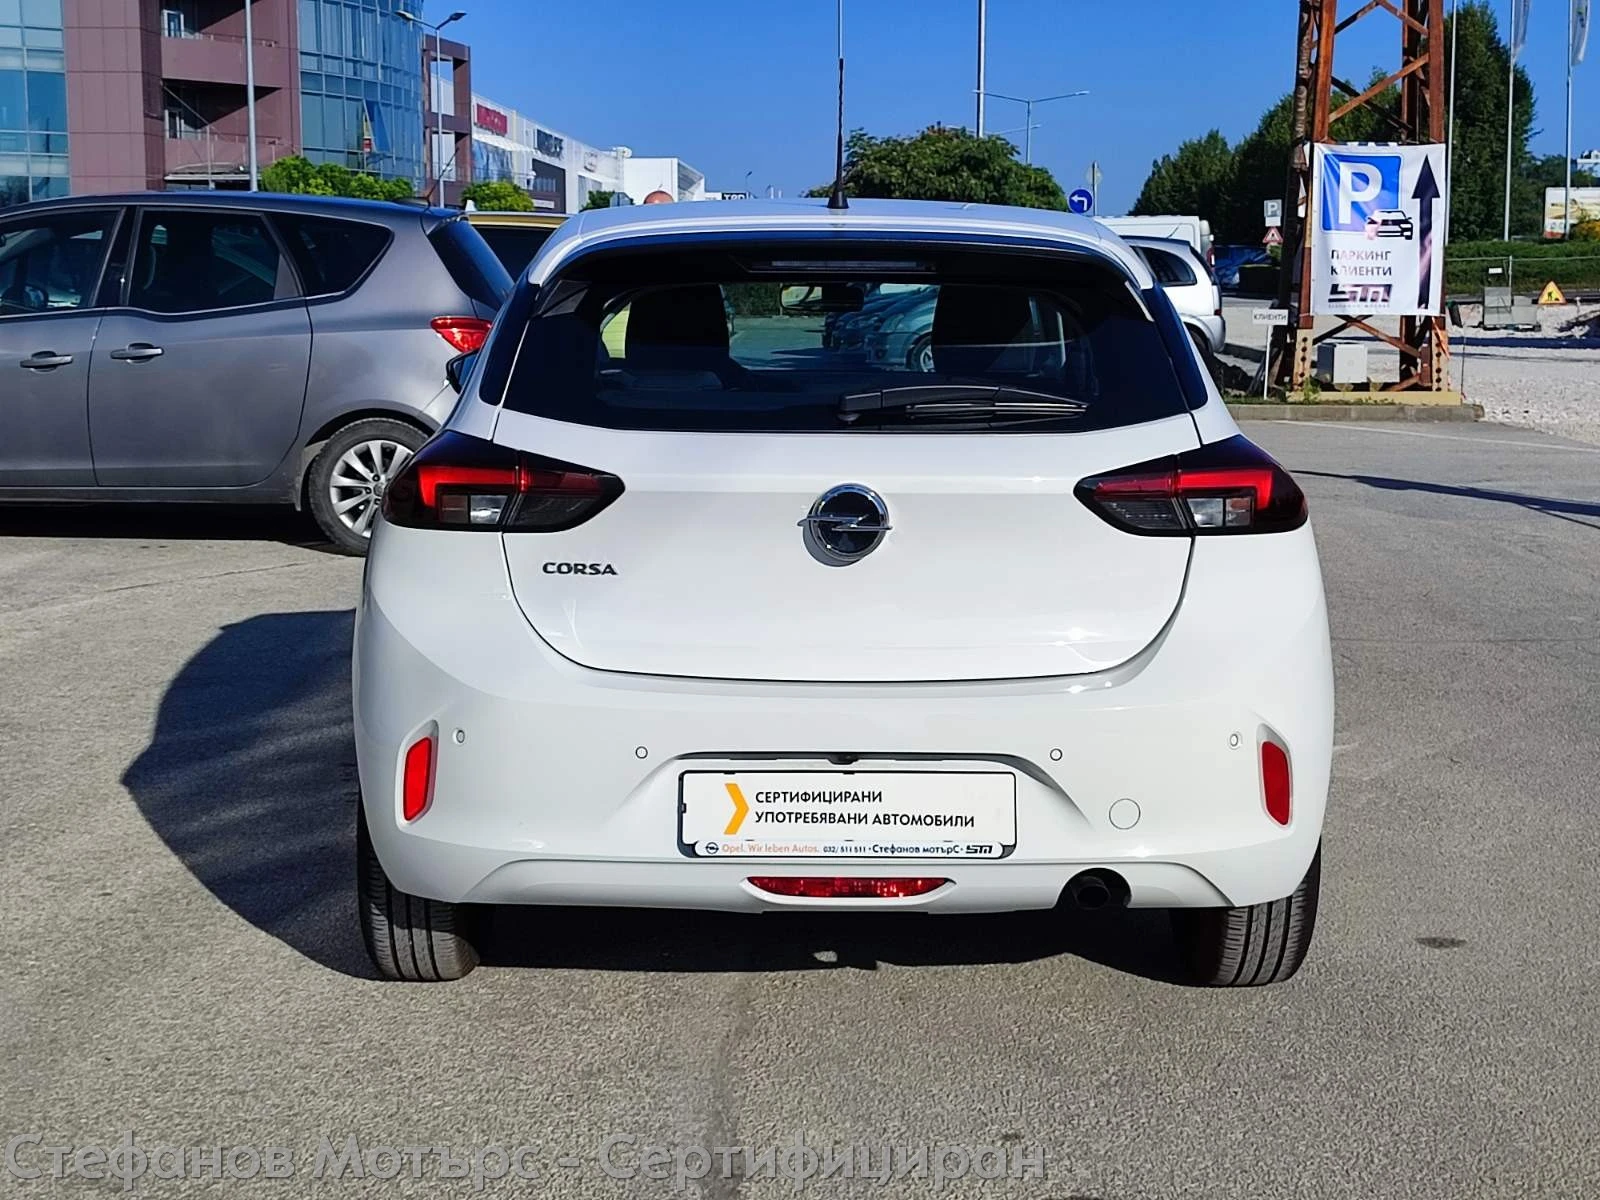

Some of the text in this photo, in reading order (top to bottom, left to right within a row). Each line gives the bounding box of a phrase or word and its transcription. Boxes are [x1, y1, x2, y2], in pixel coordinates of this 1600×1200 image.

[1339, 161, 1383, 225] P
[1331, 249, 1392, 261] ПАРКИНГ
[1253, 311, 1287, 322] КЛИЕНТИ
[542, 562, 618, 575] CORSA
[755, 791, 882, 804] СЕРТИФИЦИРАНИ
[755, 811, 975, 828] УПОТРЕБЯВАНИ АВТОМОБИЛИ
[765, 844, 789, 853] leben
